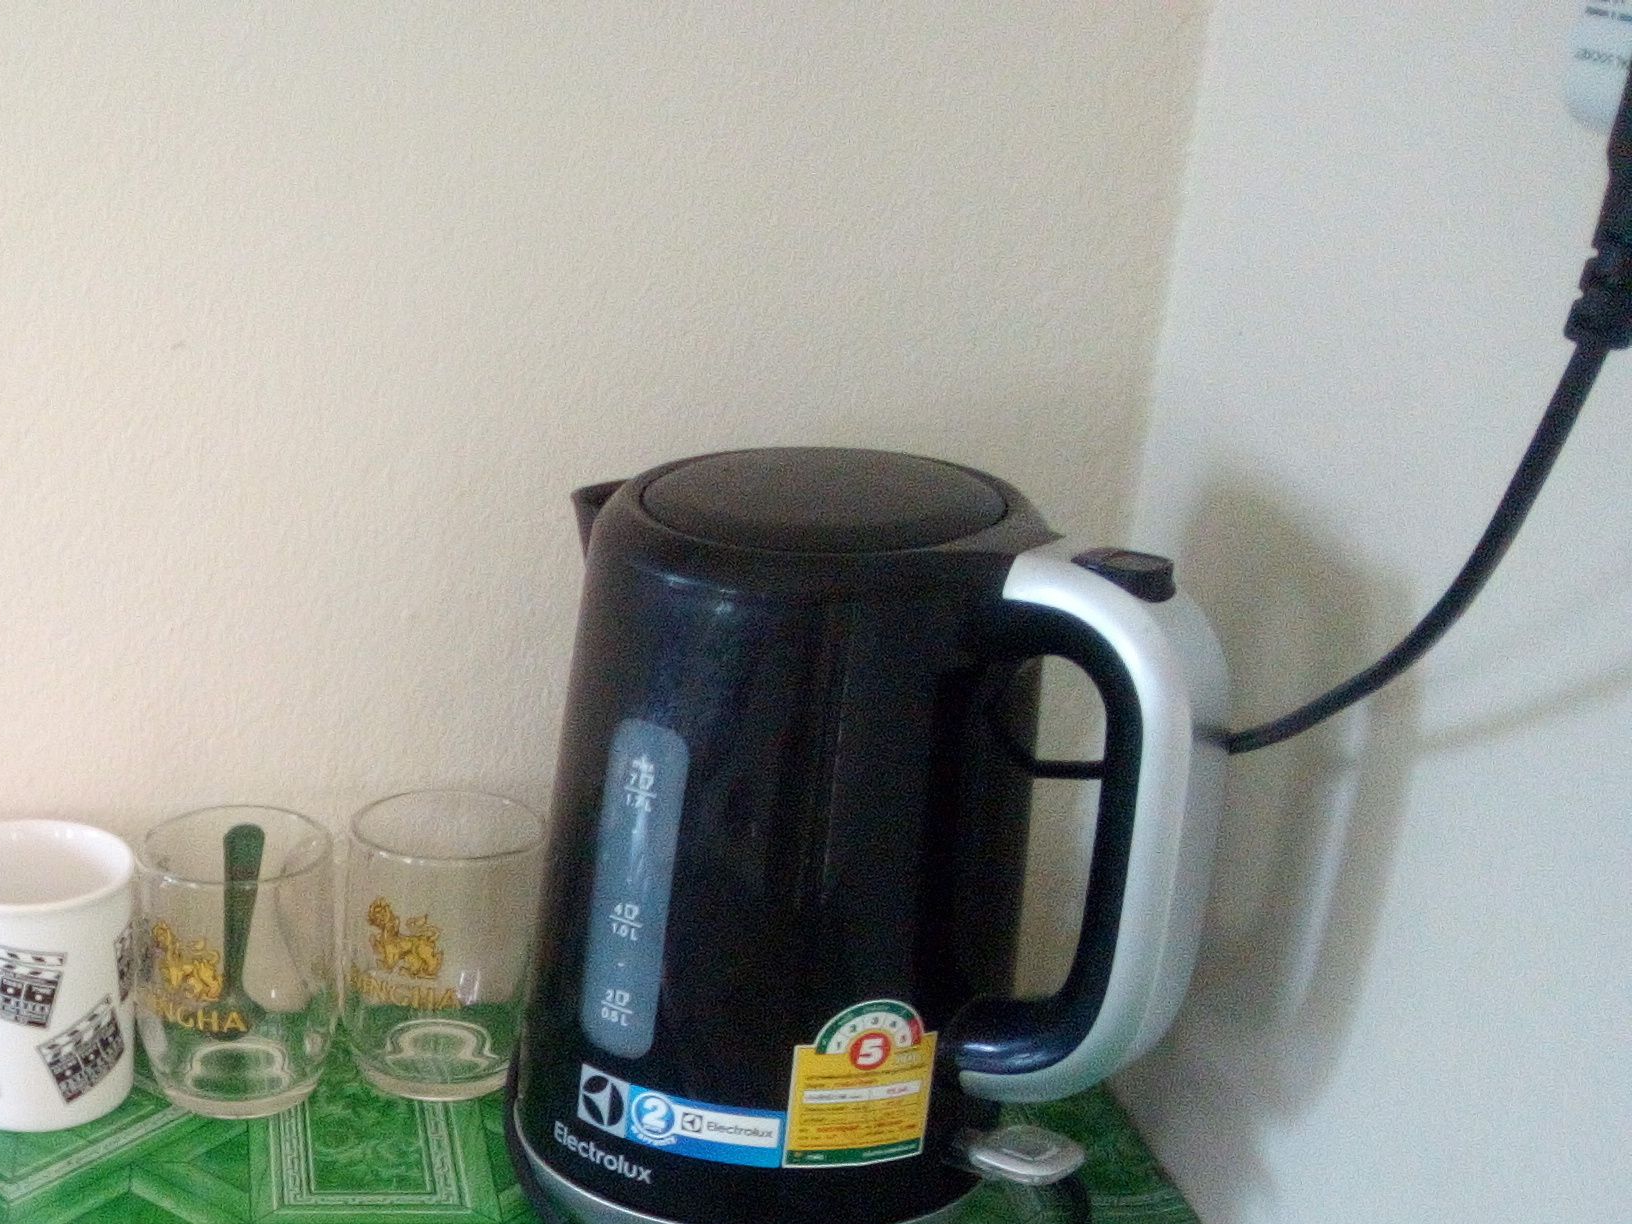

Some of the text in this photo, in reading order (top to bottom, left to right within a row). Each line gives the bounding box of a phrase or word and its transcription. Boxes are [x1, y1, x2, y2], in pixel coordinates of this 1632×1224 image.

[857, 1037, 885, 1067] 5
[641, 1097, 668, 1132] 2
[706, 1120, 775, 1140] Electrolux
[553, 1120, 652, 1185] Electrolux
